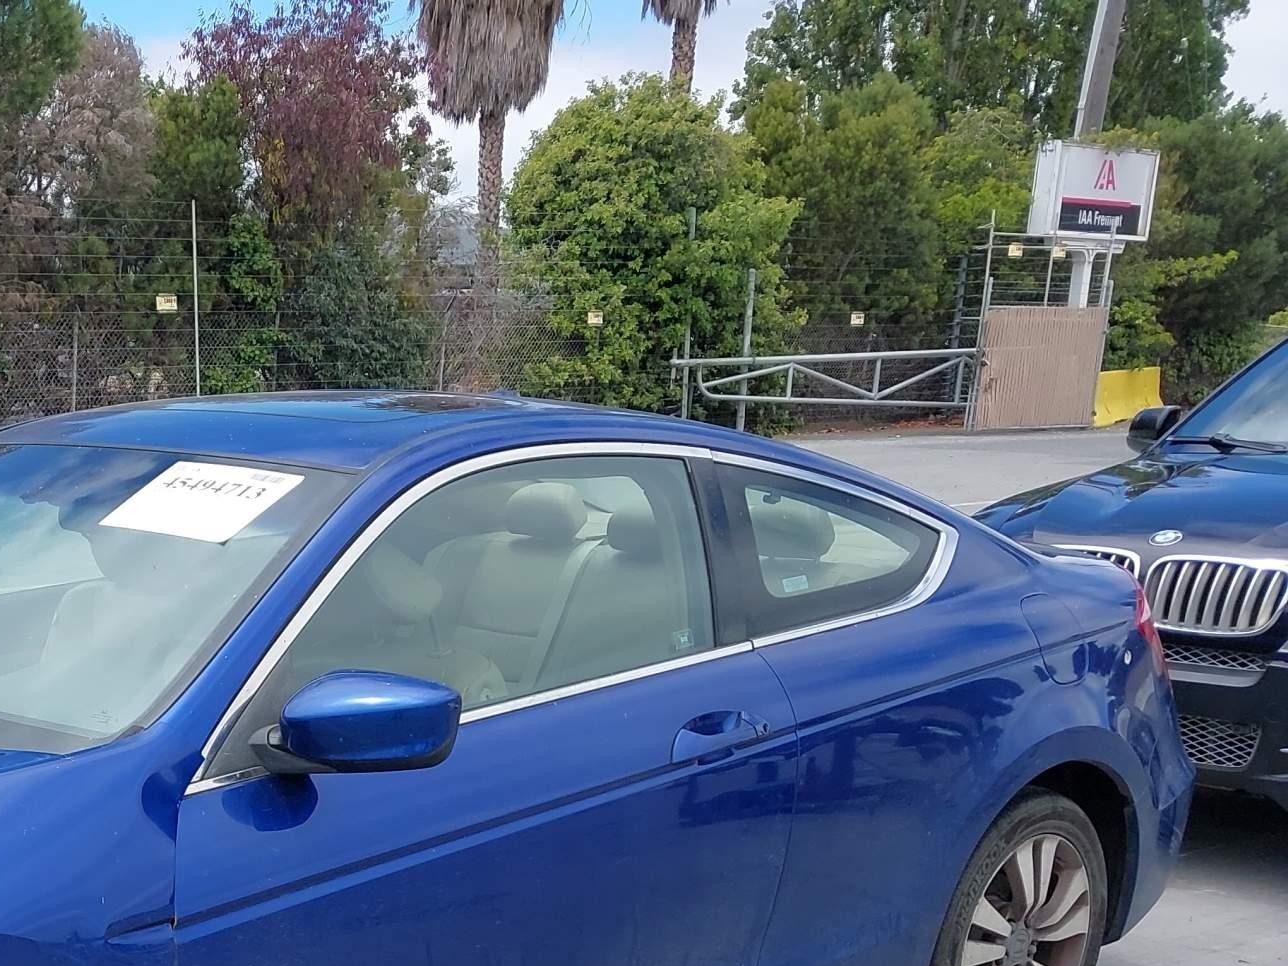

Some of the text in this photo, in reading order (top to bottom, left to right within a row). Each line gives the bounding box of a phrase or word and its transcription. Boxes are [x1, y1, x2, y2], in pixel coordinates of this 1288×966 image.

[1078, 209, 1123, 227] IAA Fremnt
[163, 477, 267, 500] 45494713
